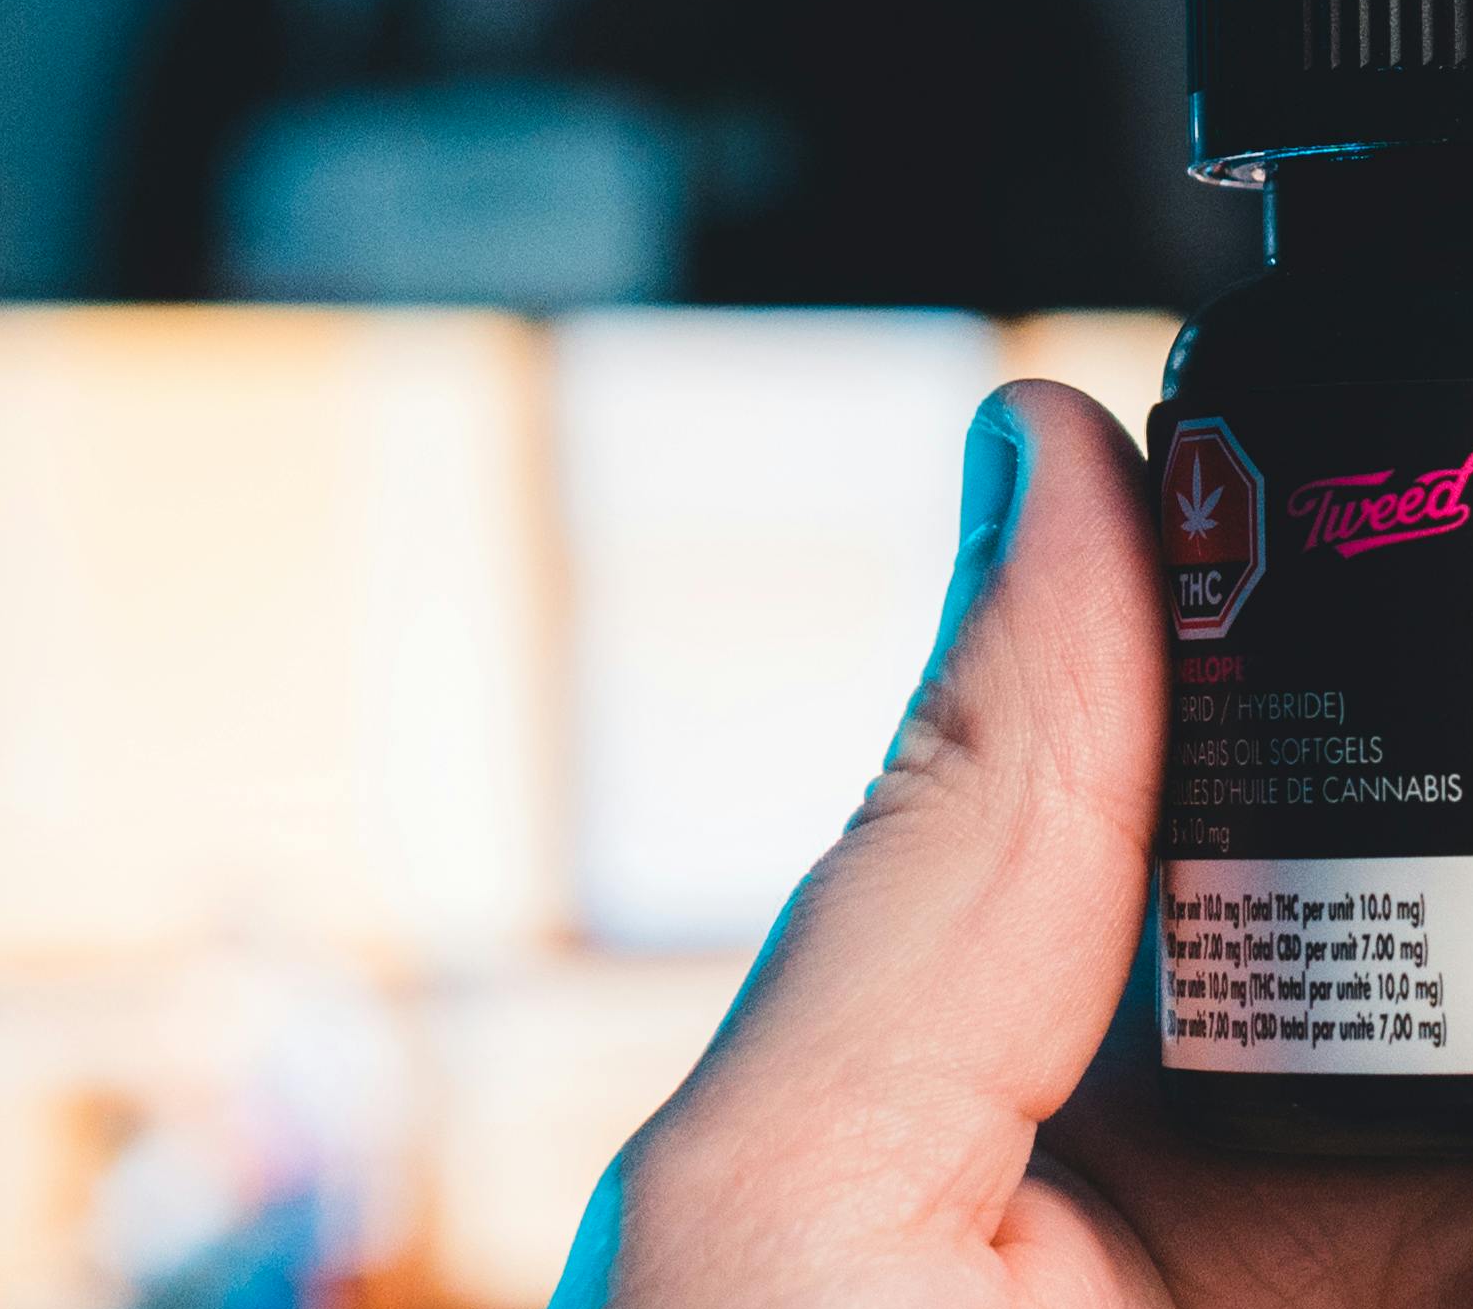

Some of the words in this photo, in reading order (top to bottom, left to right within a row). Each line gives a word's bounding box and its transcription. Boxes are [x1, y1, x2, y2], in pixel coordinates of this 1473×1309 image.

[1179, 570, 1222, 607] THC
[1238, 691, 1345, 725] HYBRIDE)
[1234, 738, 1263, 766] OIL
[1270, 736, 1384, 765] SOFTGELS
[1214, 777, 1278, 806] D'HUILE
[1286, 777, 1314, 805] DE
[1323, 773, 1464, 804] CANNABIS
[1208, 827, 1230, 853] mg
[1188, 893, 1201, 921] unit
[1204, 893, 1222, 921] 10.0
[1224, 901, 1239, 929] mg
[1243, 891, 1272, 928] (Total
[1276, 893, 1299, 922] THC
[1303, 900, 1324, 929] per
[1329, 892, 1355, 921] unit
[1360, 893, 1391, 922] 10.0
[1397, 893, 1425, 928] mg)
[1188, 932, 1202, 960] unit
[1203, 932, 1223, 961] 7.00
[1225, 940, 1240, 969] mg
[1244, 932, 1274, 968] (Total
[1277, 933, 1301, 962] CBD
[1306, 941, 1327, 969] per
[1331, 933, 1358, 961] unit
[1362, 933, 1395, 961] 7.00
[1400, 933, 1429, 968] mg)
[1209, 972, 1229, 1004] 10,0
[1231, 980, 1246, 1008] mg
[1250, 972, 1275, 1007] (THC
[1279, 972, 1306, 1000] total
[1310, 980, 1332, 1009] par
[1337, 972, 1372, 1000] unité
[1378, 972, 1410, 1005] 10,0
[1415, 972, 1443, 1007] mg)
[1208, 1011, 1229, 1043] 7,00
[1232, 1018, 1247, 1047] mg
[1251, 1011, 1277, 1046] (CBD
[1280, 1011, 1308, 1039] total
[1312, 1019, 1335, 1048] par
[1340, 1011, 1375, 1040] unité
[1380, 1012, 1413, 1045] 7,00
[1418, 1012, 1447, 1047] mg)
